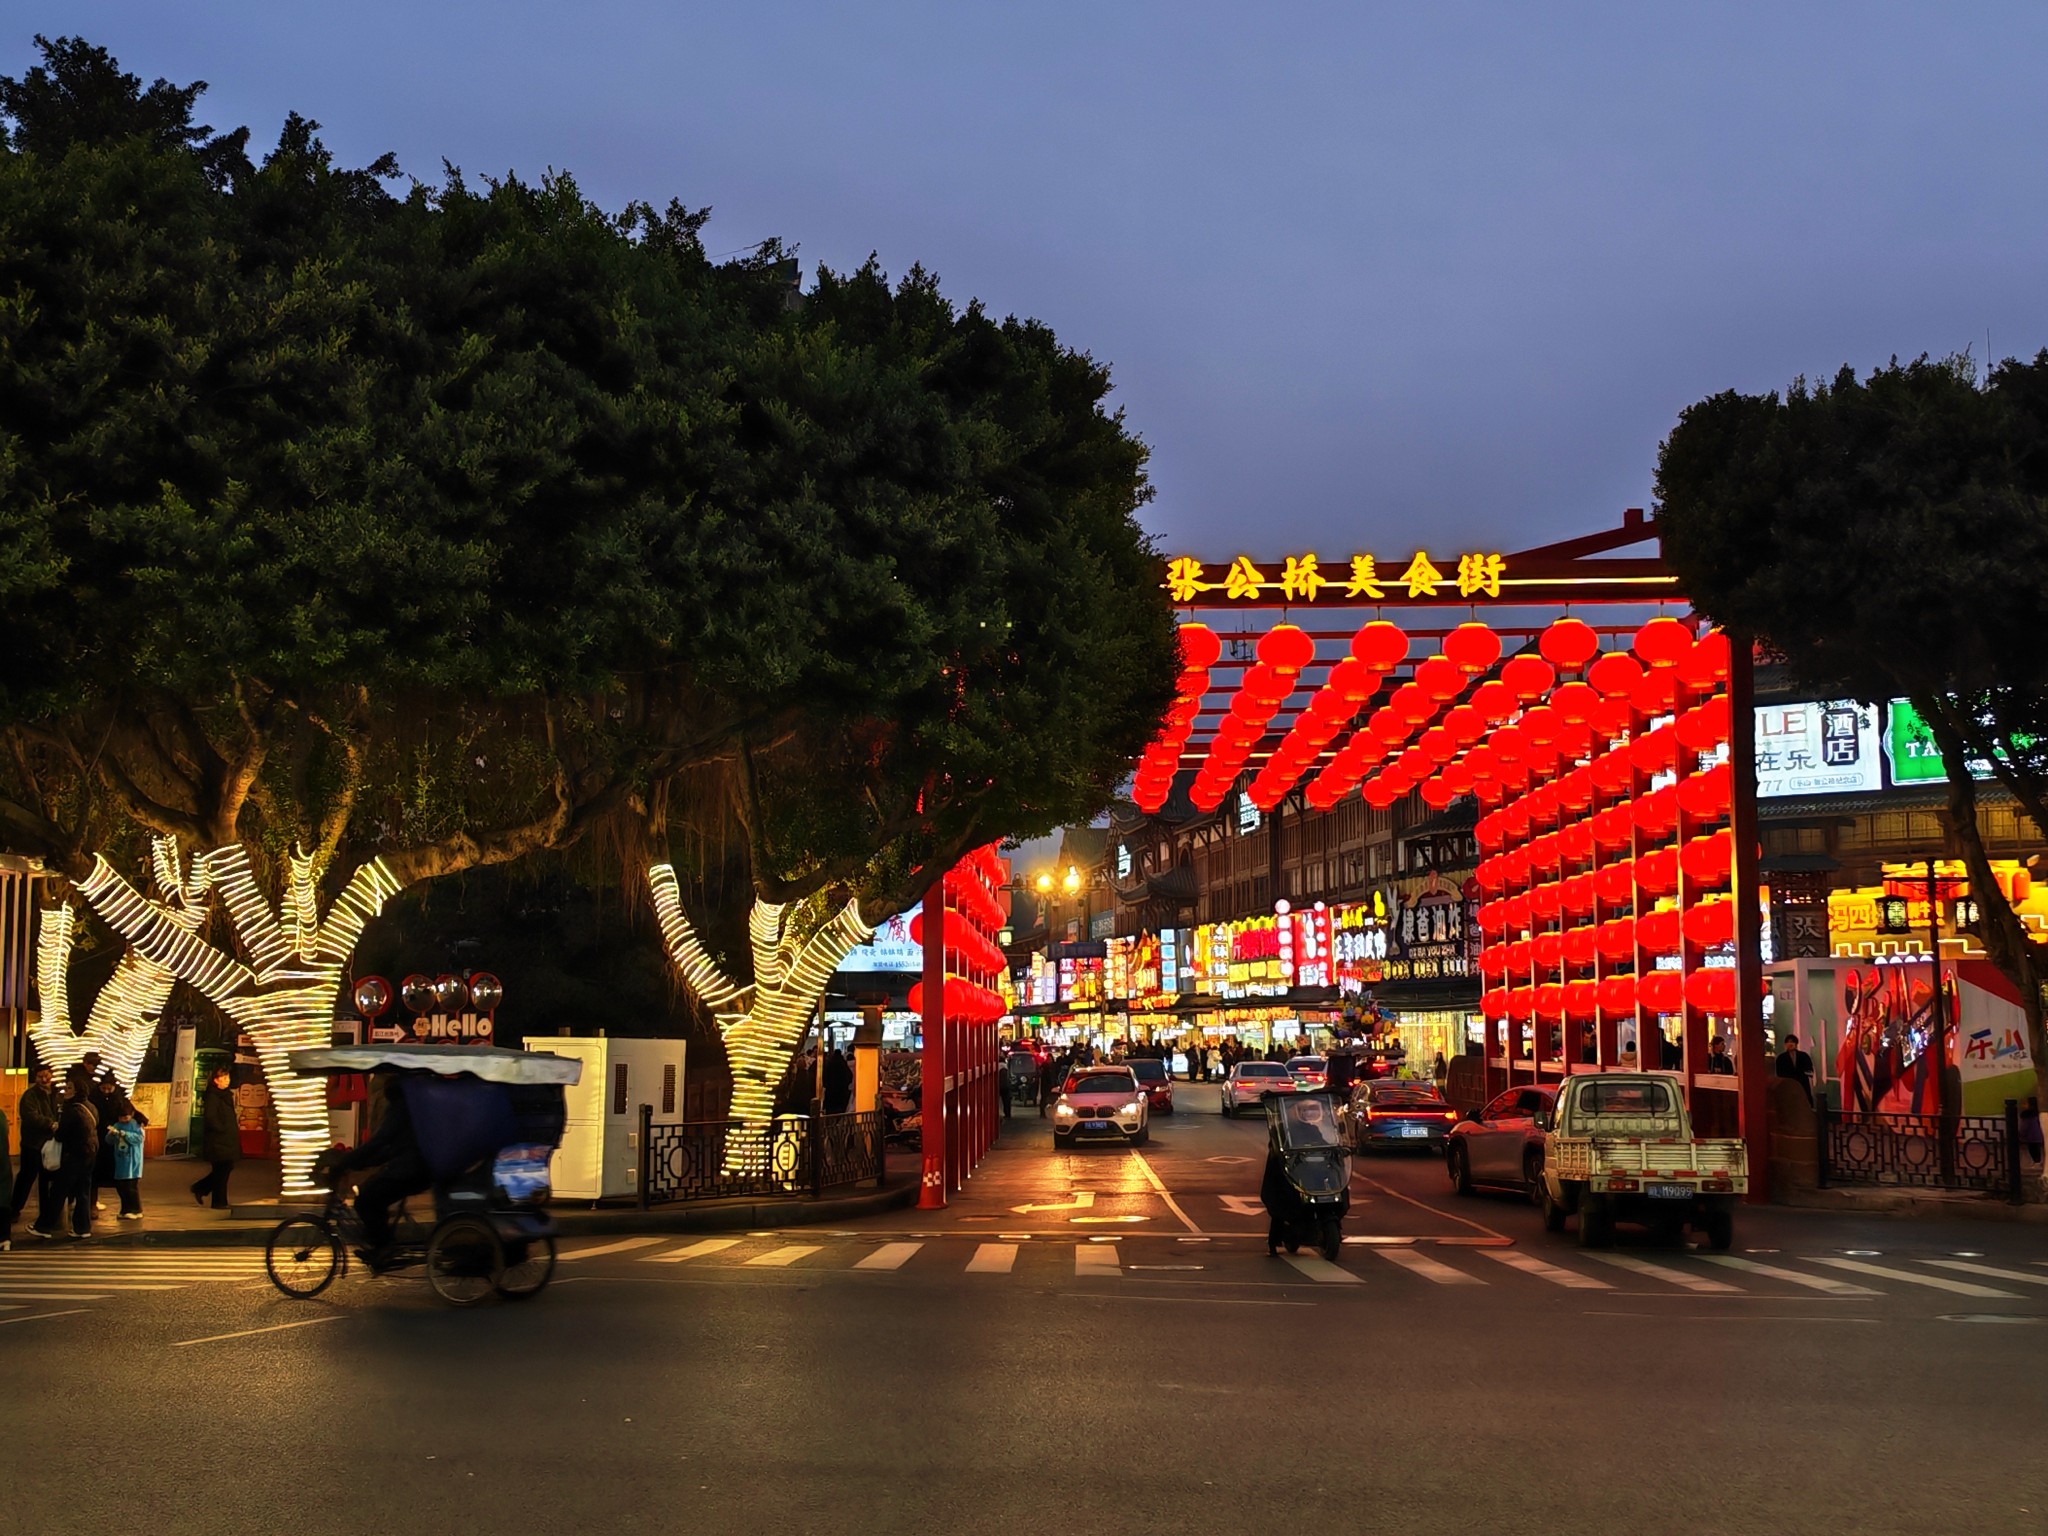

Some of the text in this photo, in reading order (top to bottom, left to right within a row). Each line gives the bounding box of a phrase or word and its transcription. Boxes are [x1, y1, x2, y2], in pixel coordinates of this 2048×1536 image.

[1166, 551, 1506, 602] 张公桥美食街
[1825, 712, 1857, 764] 酒店
[431, 1013, 493, 1038] Hello
